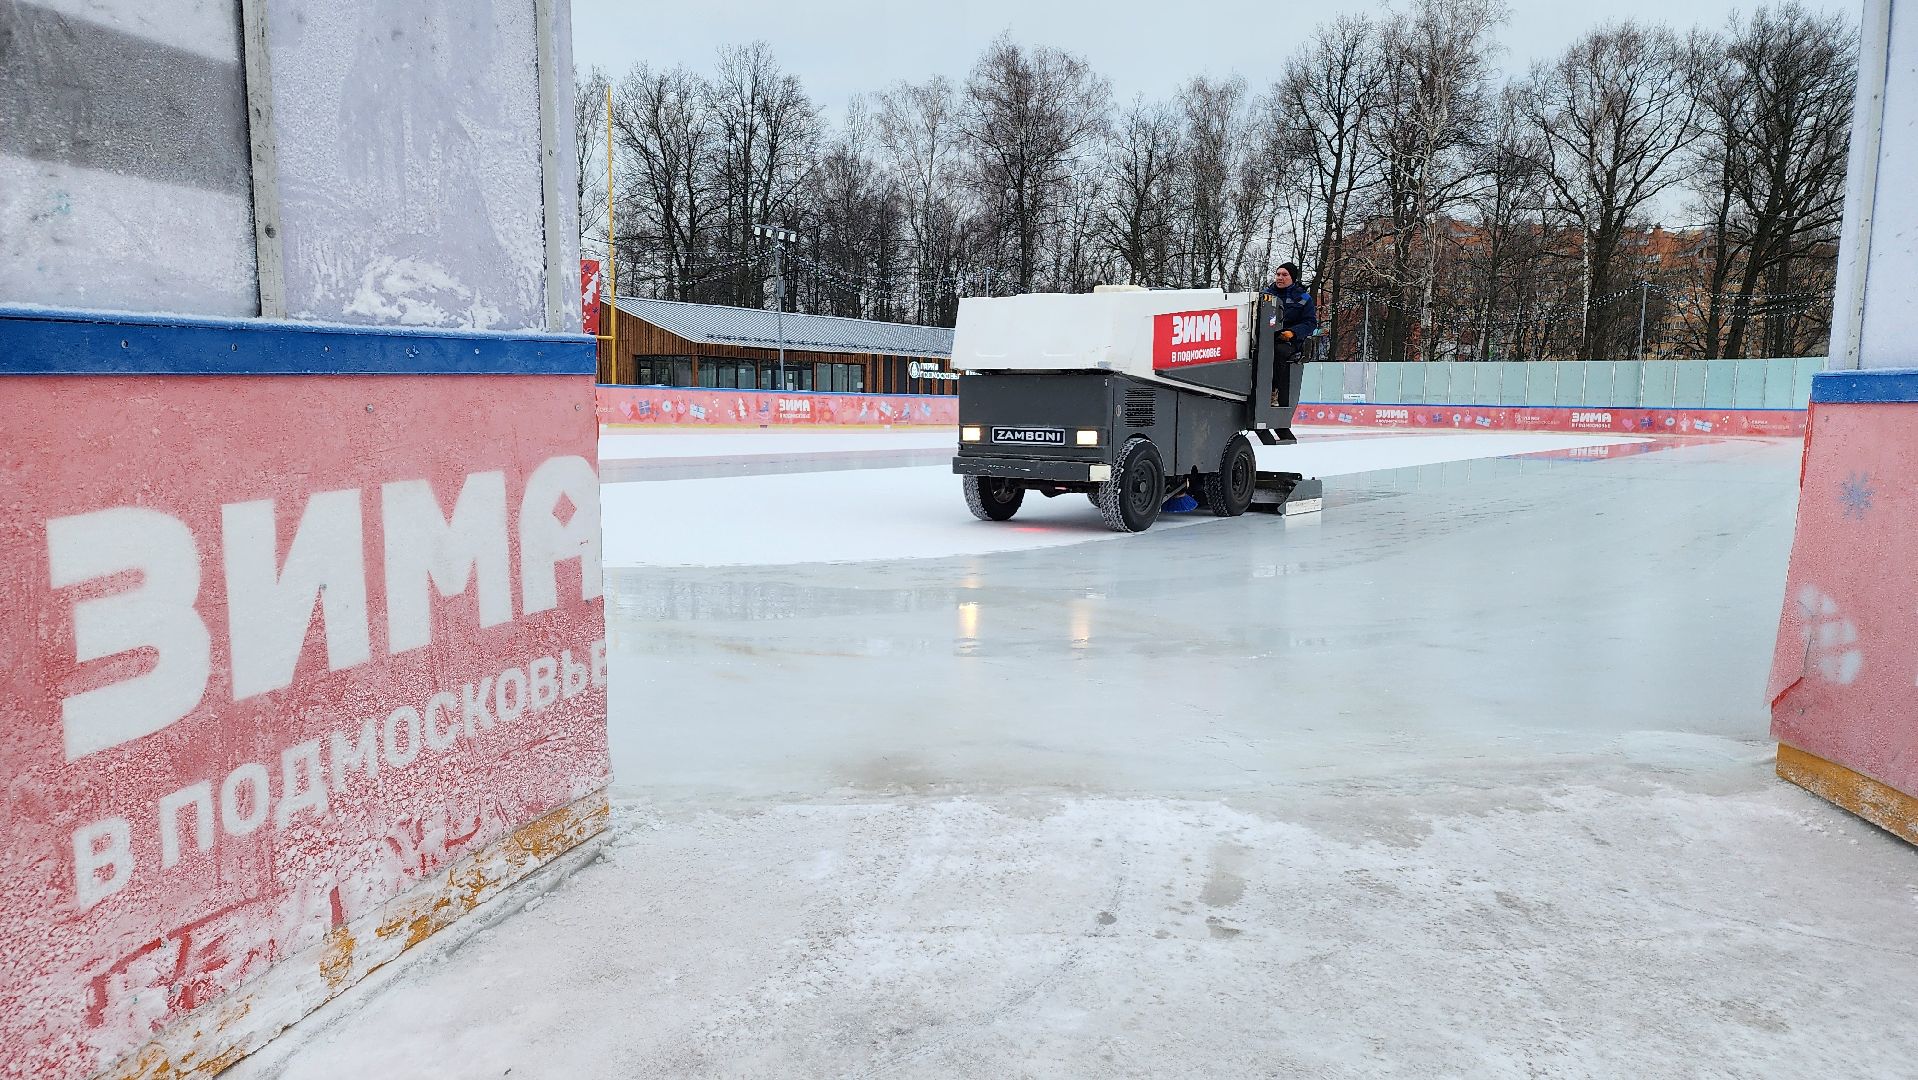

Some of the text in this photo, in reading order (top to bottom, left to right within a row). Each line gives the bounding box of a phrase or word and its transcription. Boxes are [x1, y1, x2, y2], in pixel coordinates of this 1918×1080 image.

[1171, 313, 1221, 346] ЗИМА
[1171, 347, 1222, 363] В ПОДМОСКОВЬЕ
[779, 398, 810, 411] ЗИМА
[1375, 409, 1408, 419] ЗИМА
[1571, 412, 1612, 423] ЗИМА
[996, 430, 1061, 442] ZAMBONI
[46, 455, 604, 762] ЗИМА
[73, 639, 606, 912] В ПОДМОСКОВЬЕ
